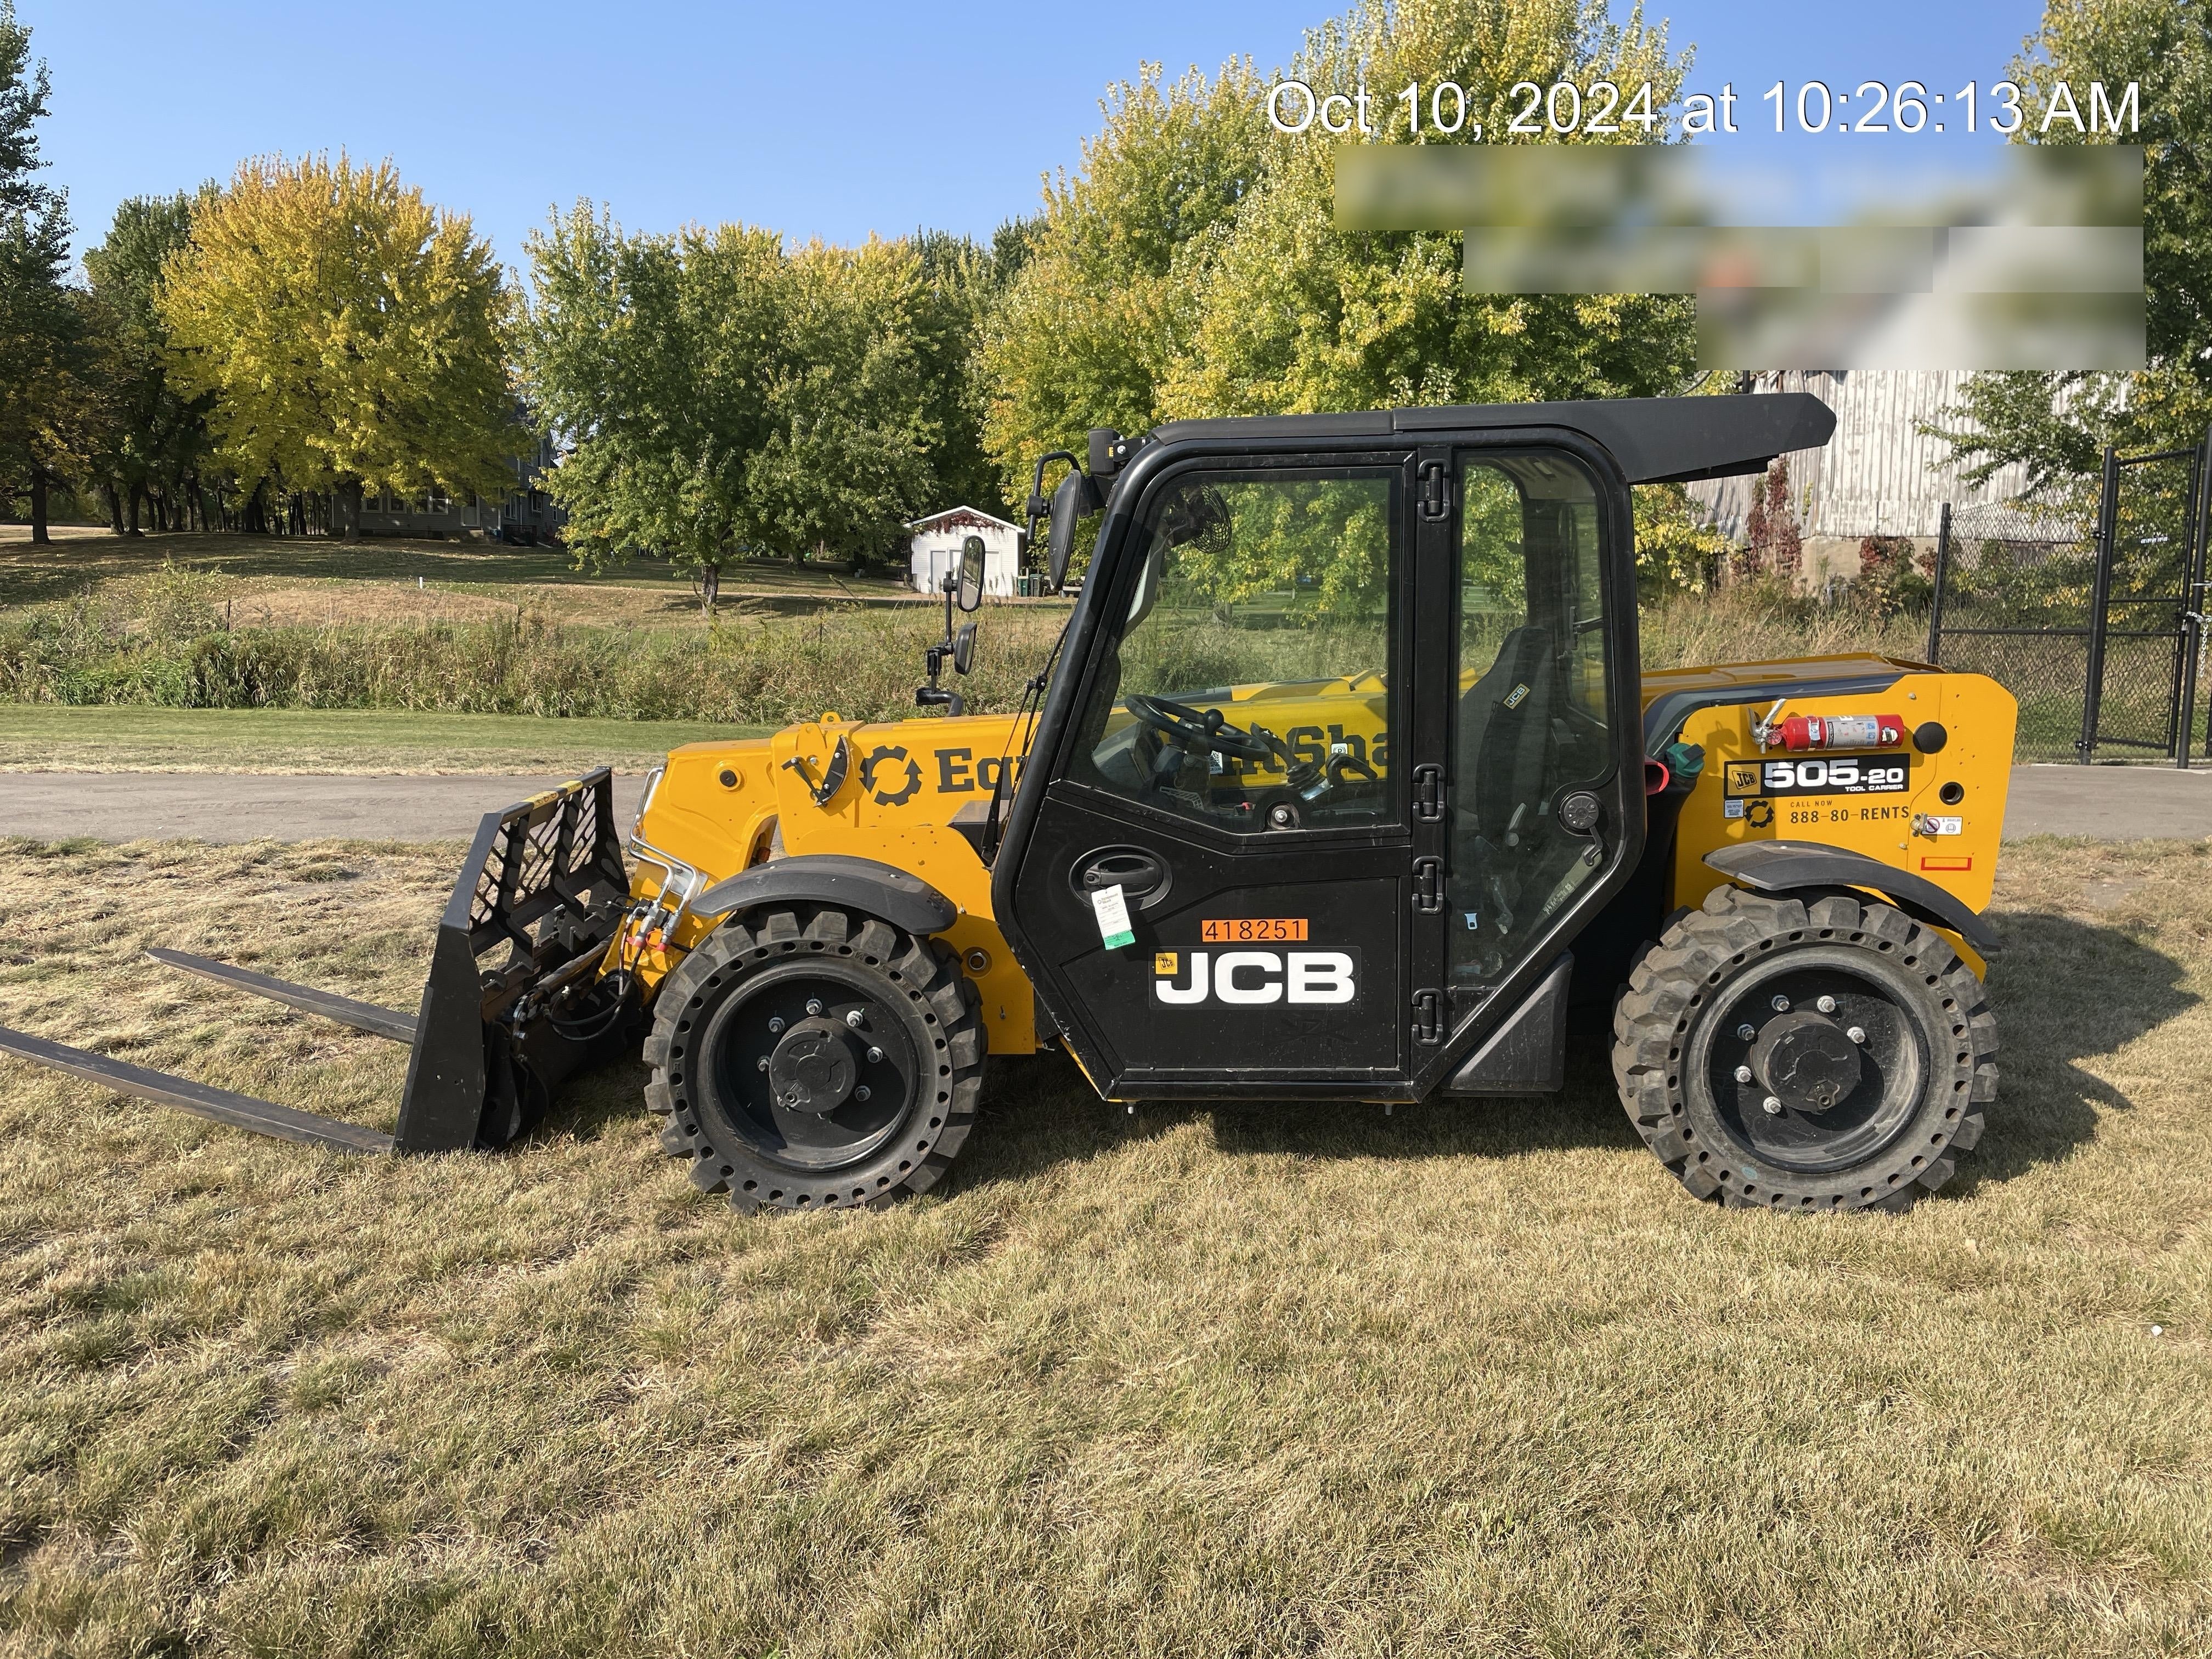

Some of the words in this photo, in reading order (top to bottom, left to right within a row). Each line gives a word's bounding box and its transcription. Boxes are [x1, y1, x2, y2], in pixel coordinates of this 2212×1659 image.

[1509, 686, 1526, 706] JCB
[1736, 772, 1756, 788] JCB
[1764, 759, 1904, 788] 505-20
[1204, 919, 1300, 940] 418251
[1155, 951, 1356, 1004] JCB
